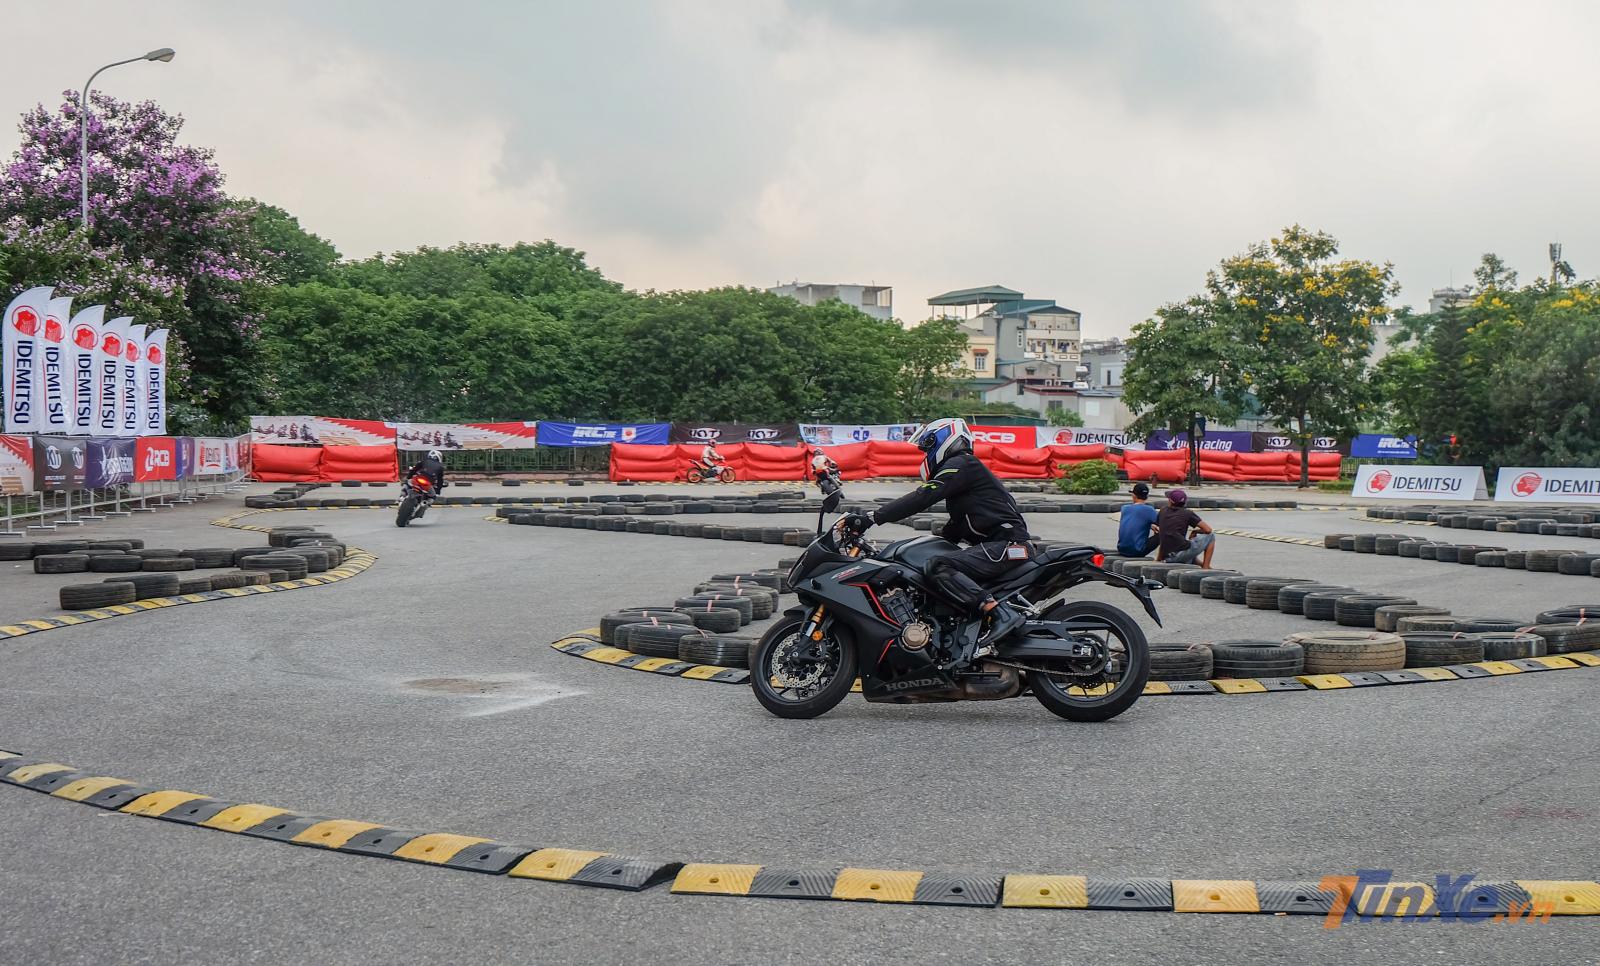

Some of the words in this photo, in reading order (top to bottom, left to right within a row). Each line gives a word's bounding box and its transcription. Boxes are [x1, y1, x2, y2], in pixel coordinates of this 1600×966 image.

[14, 340, 33, 424] IDEMITSU
[45, 347, 64, 424] IDEMITSU
[77, 354, 92, 427] IDEMITSU
[101, 360, 117, 429] IDEMITSU
[124, 365, 136, 430] IDEMITSU
[148, 368, 160, 429] IDEMITSU
[971, 431, 1016, 444] RCB
[1075, 433, 1129, 445] IDEMITSU
[1392, 476, 1462, 492] IDEMITSU
[885, 677, 945, 691] HONDA
